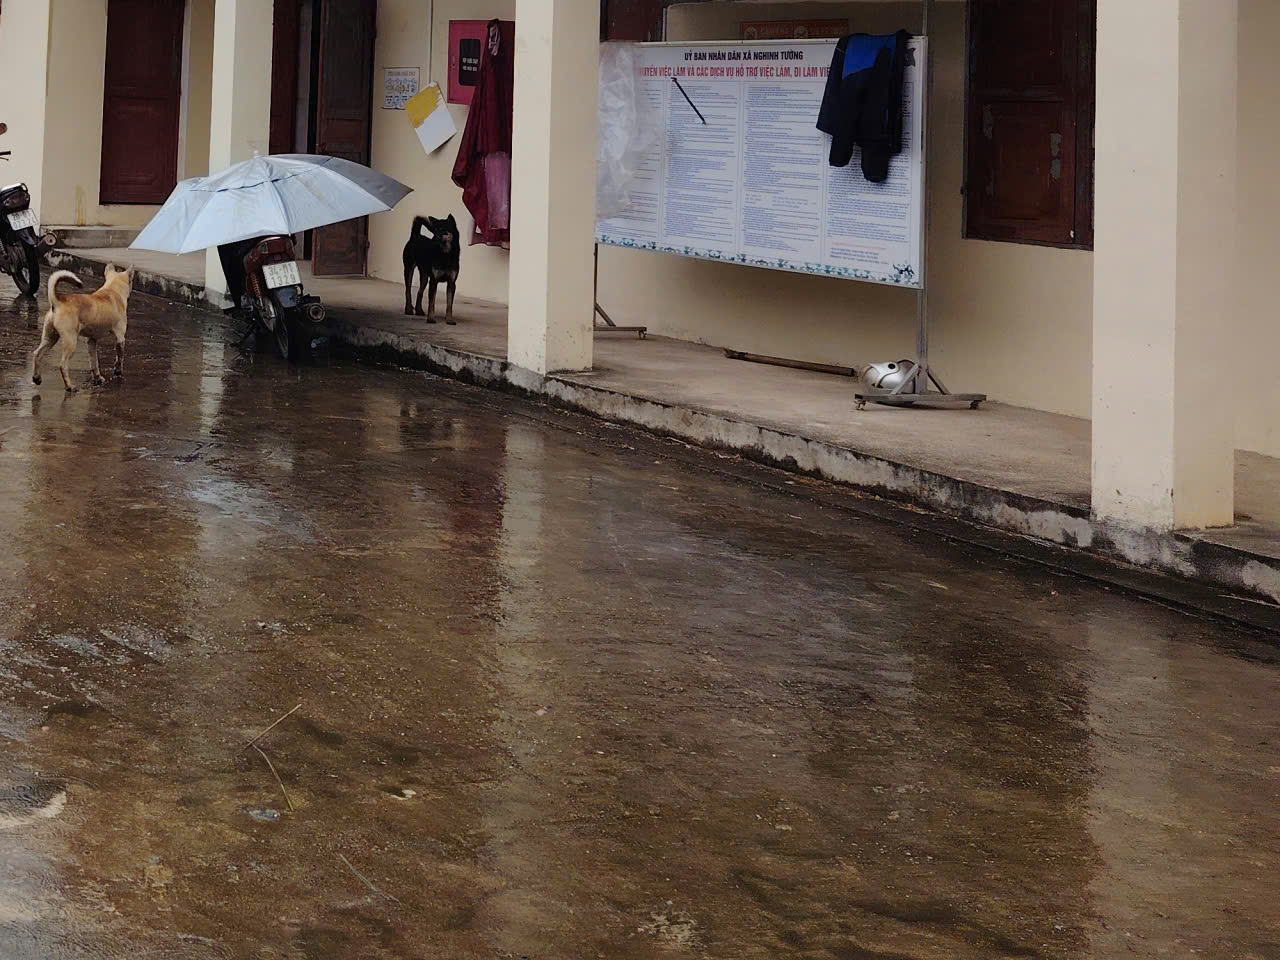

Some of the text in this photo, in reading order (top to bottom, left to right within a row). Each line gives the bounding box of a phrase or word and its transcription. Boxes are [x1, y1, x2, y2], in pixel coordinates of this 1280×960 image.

[694, 52, 707, 61] BAN
[708, 50, 726, 61] NHÂN
[727, 50, 741, 61] DÂN
[696, 65, 709, 77] CÁC
